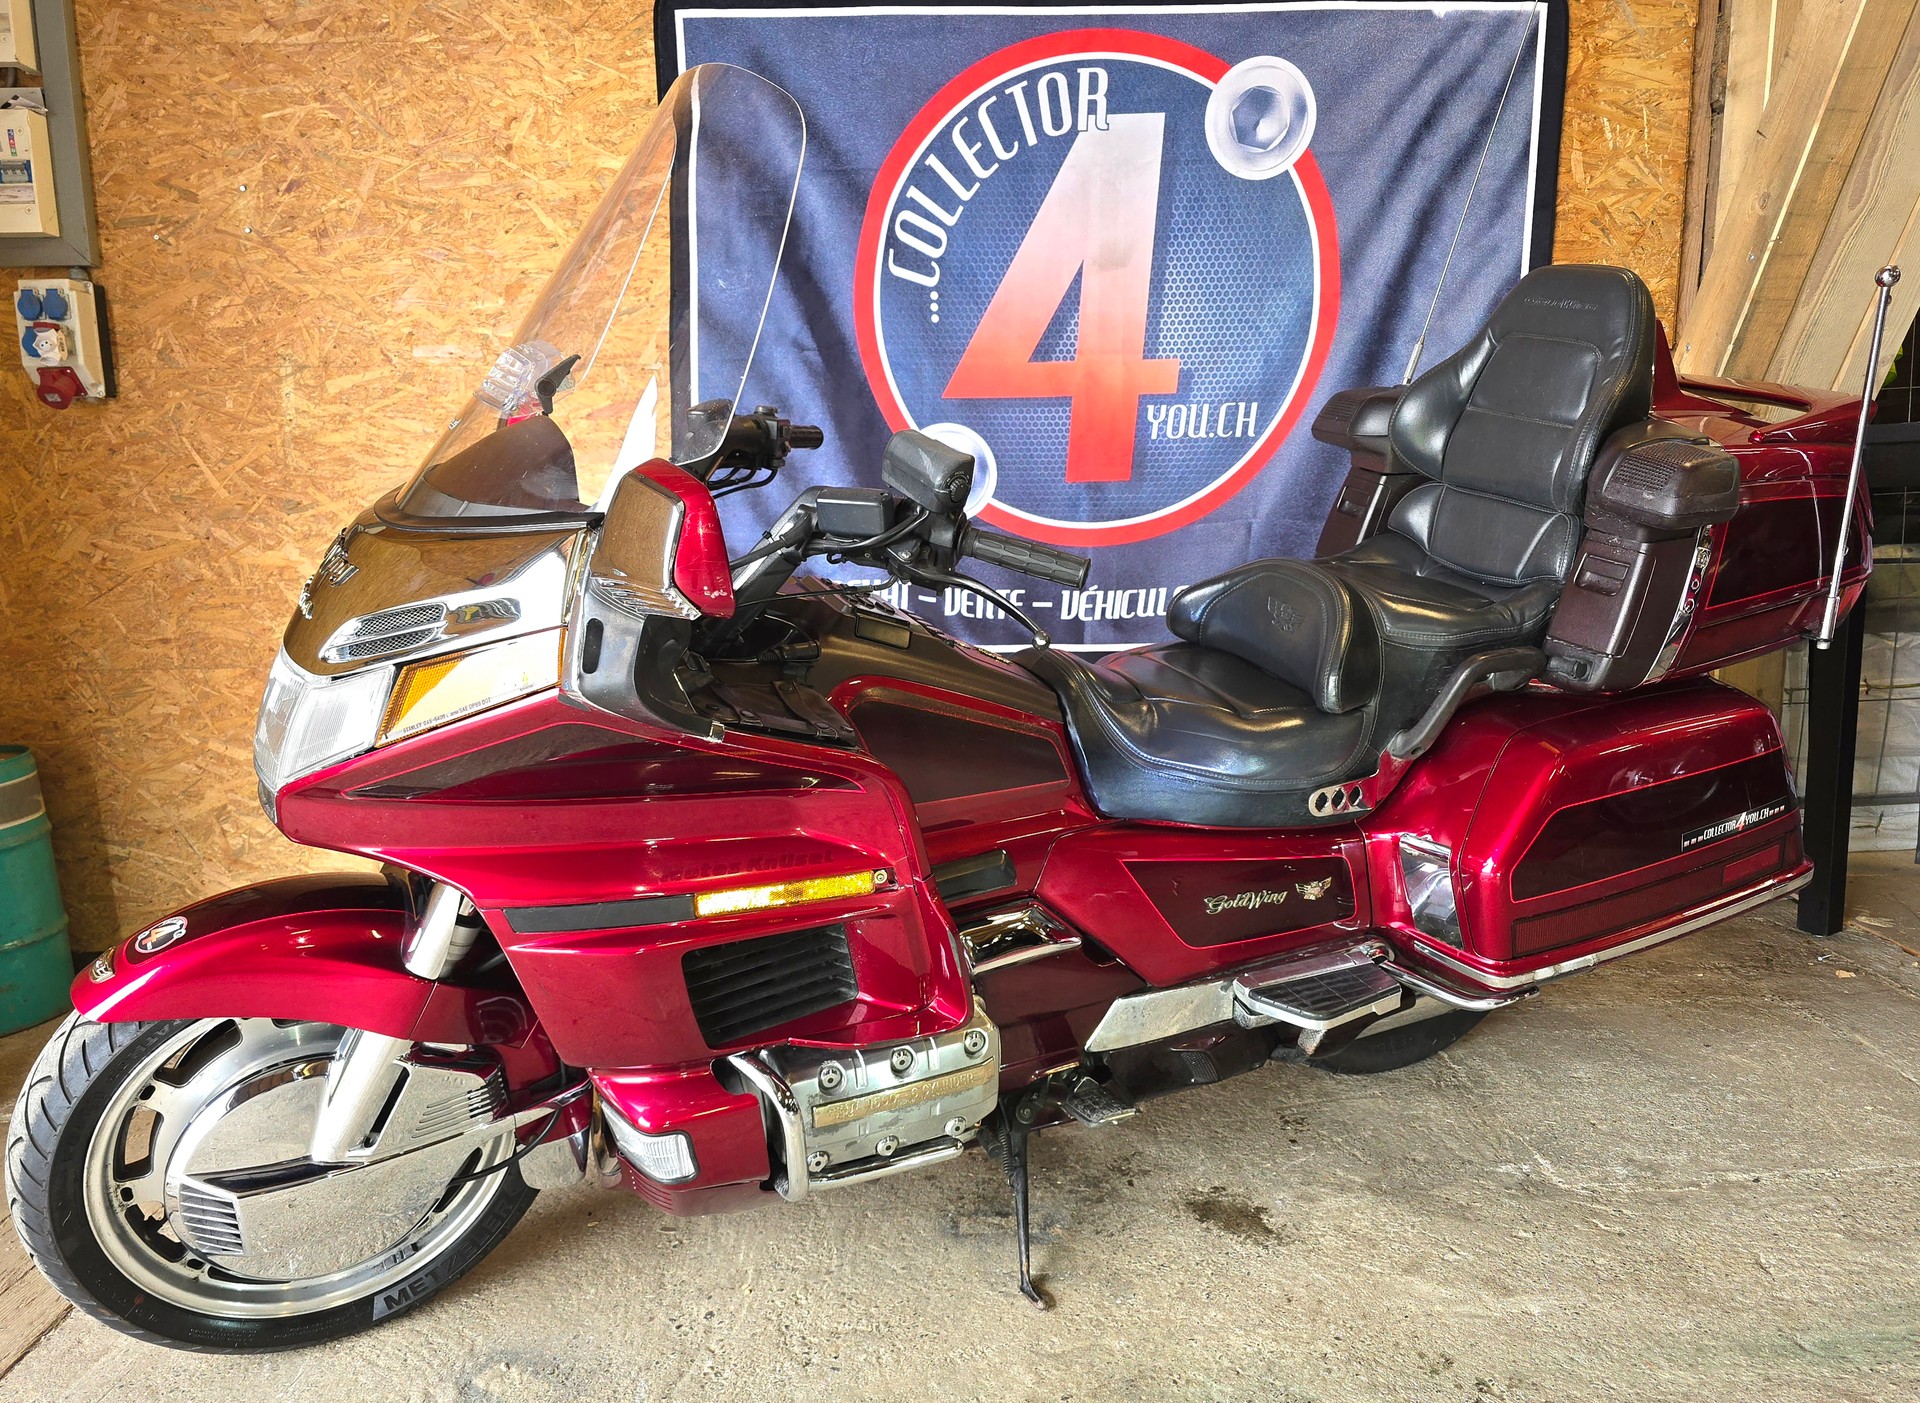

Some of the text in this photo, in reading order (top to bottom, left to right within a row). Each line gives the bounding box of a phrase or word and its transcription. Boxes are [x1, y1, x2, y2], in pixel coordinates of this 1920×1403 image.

[941, 111, 1180, 483] 4
[1147, 401, 1258, 440] YOU.CH
[1060, 584, 1191, 622] VÉHICUL
